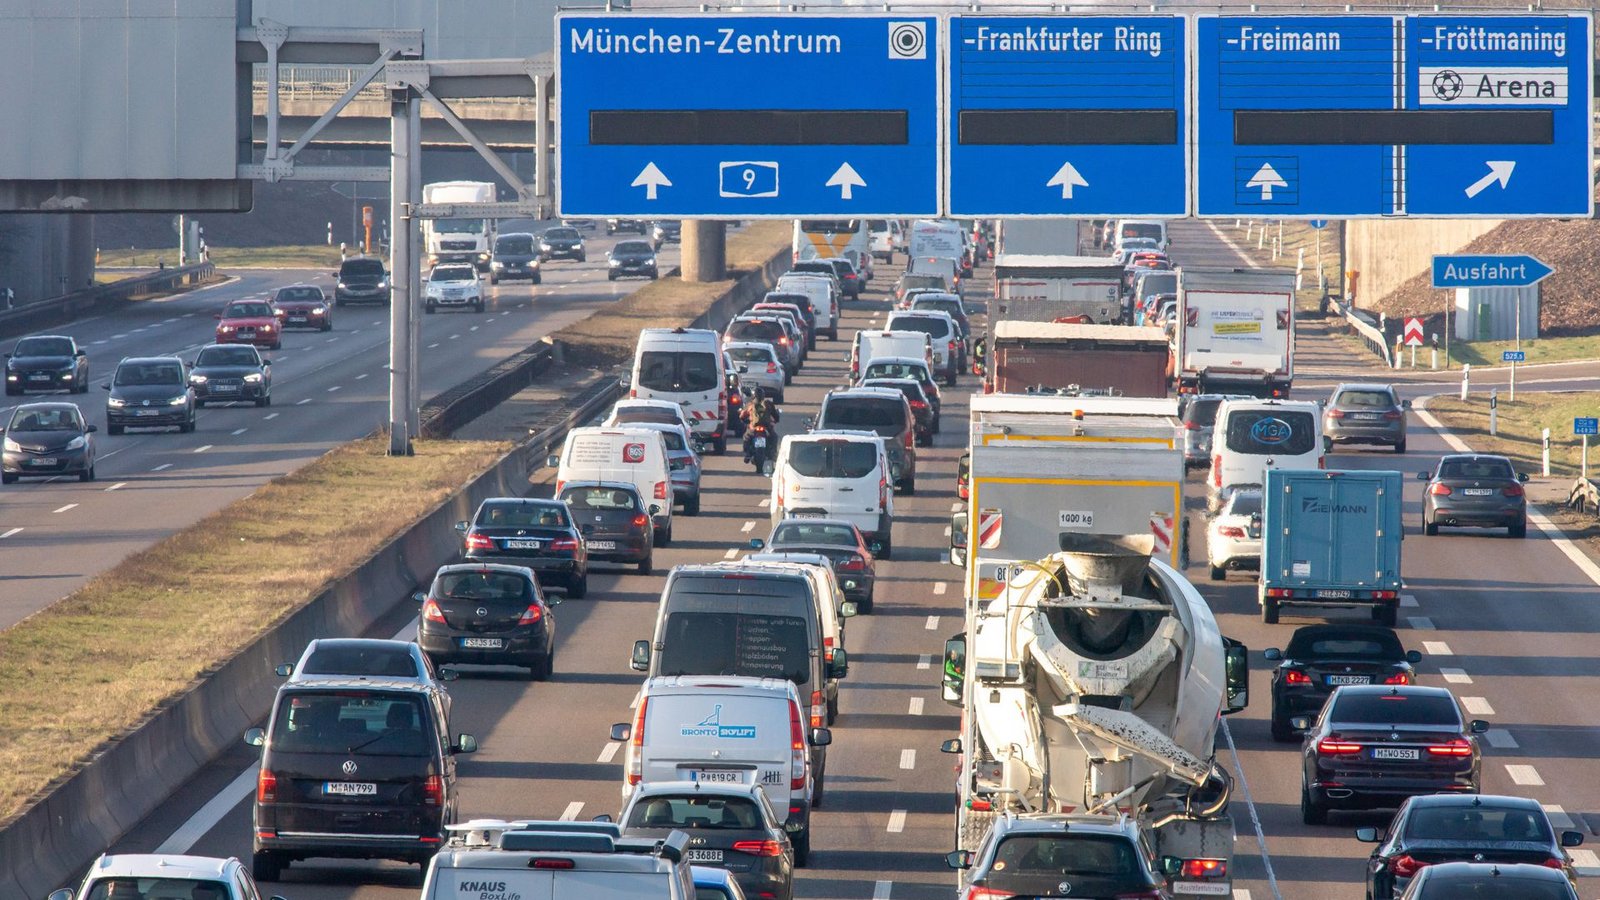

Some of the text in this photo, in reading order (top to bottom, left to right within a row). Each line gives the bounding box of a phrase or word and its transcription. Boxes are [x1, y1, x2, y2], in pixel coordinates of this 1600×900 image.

[571, 28, 841, 54] München-Zentrum
[963, 26, 1161, 57] -Frankfurter Ring
[1227, 26, 1340, 51] -Freimann
[1421, 26, 1566, 57] -Fröttmaning
[1476, 75, 1555, 98] Arena
[743, 169, 756, 190] 9
[1443, 263, 1526, 280] Ausfahrt
[1254, 424, 1289, 437] MGA
[1082, 514, 1093, 525] kg
[720, 729, 755, 737] SKYLIFT
[460, 881, 506, 892] KNAUS
